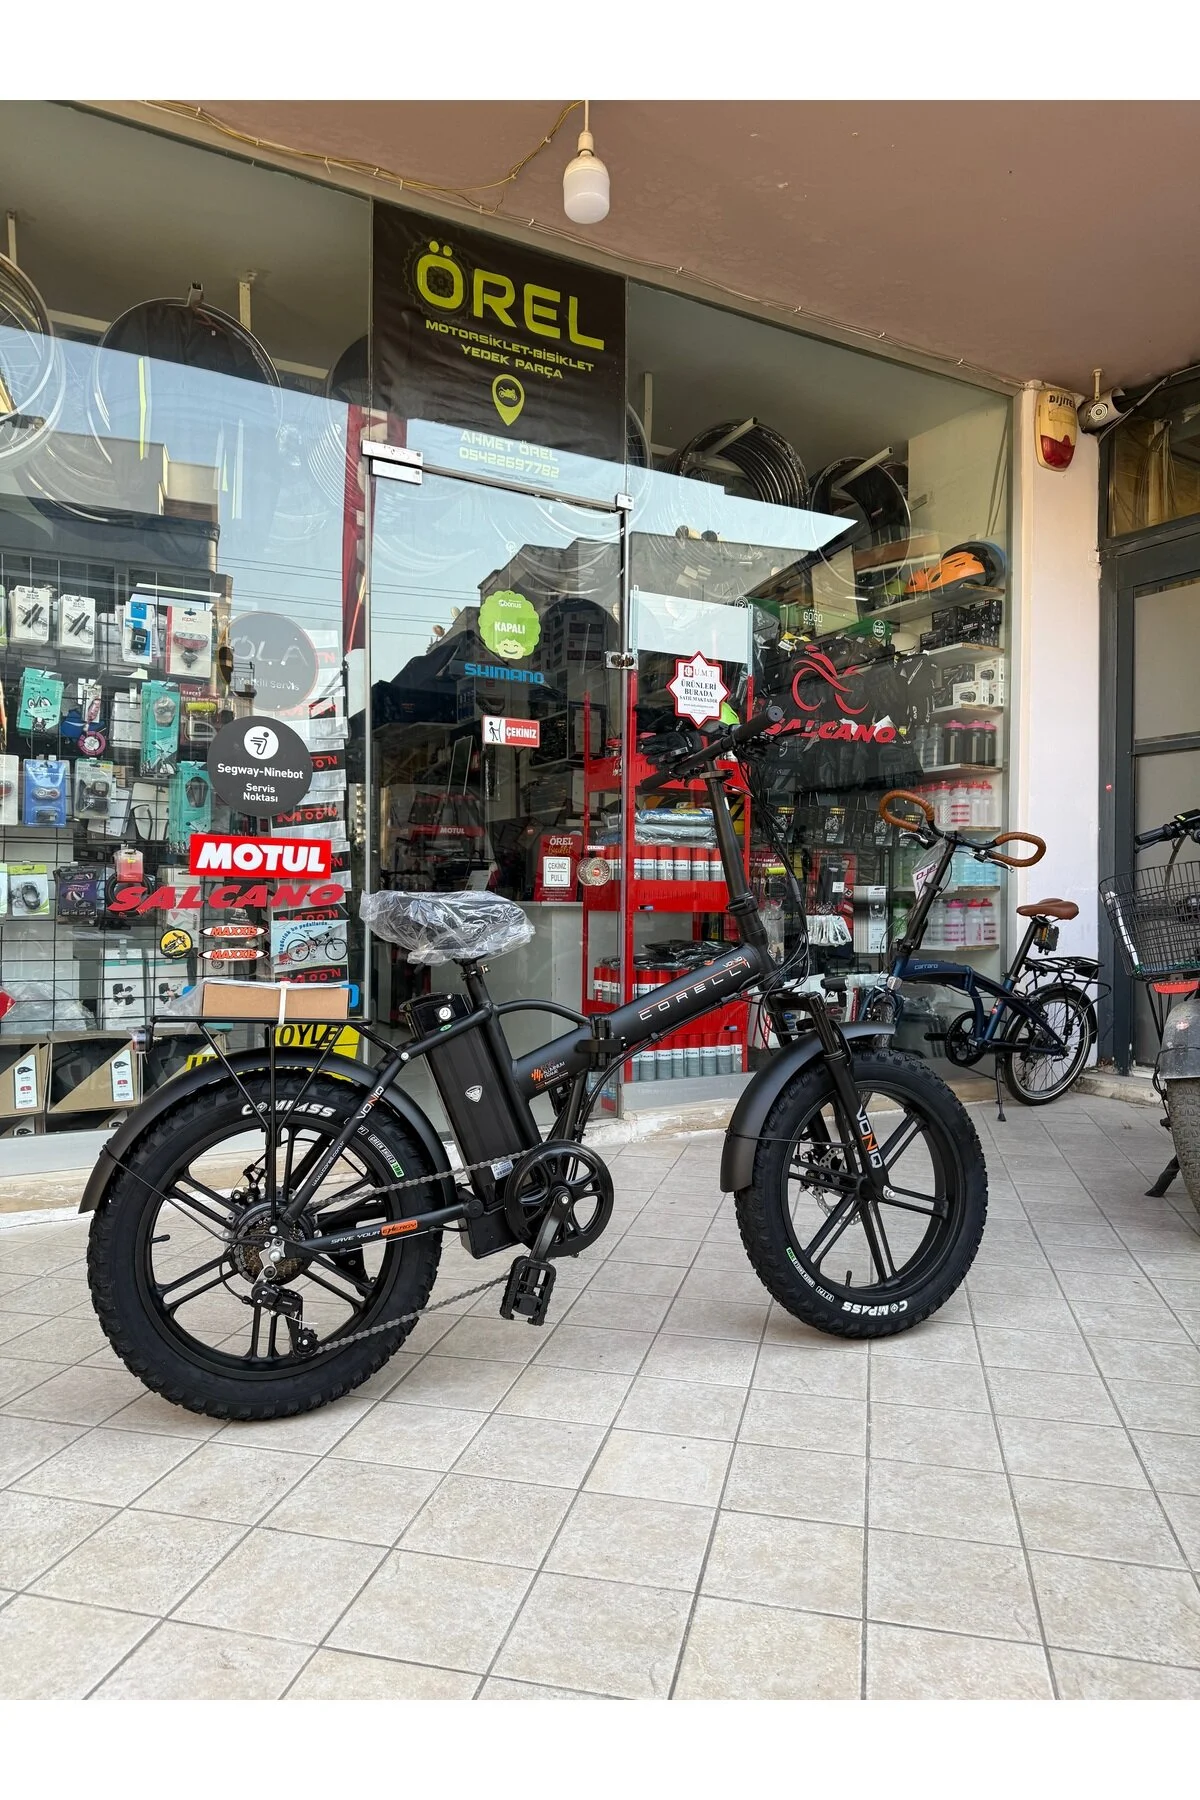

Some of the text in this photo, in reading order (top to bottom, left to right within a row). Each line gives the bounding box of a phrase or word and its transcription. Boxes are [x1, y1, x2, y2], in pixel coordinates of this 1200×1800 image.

[417, 241, 605, 351] ÖREL
[426, 319, 594, 372] MOTORSİKLET-BİSİKLET
[461, 344, 563, 379] YEDEK PARÇA
[460, 430, 559, 462] AHMET ÖREL
[459, 446, 560, 479] 05422697782
[494, 621, 525, 634] KAPALI
[464, 663, 545, 685] SHIMANO
[681, 679, 717, 690] ÜRÜNLERİ
[685, 688, 713, 697] BURADA
[505, 726, 537, 740] ÇEKİNİZ
[764, 718, 897, 743] SALCANO
[217, 763, 304, 779] Segway-Ninebot
[246, 783, 276, 793] Servis
[243, 792, 278, 802] Noktası
[549, 836, 573, 845] ÖREL
[196, 842, 326, 873] MOTUL
[550, 874, 564, 882] PULL
[107, 884, 346, 912] SALCANO
[210, 926, 258, 937] MAXXIS
[210, 949, 258, 960] MAXXIS
[356, 1085, 385, 1120] VONIQ
[856, 1104, 882, 1169] VONIQ
[331, 1236, 354, 1245] SAVE
[356, 1230, 381, 1239] YOUR
[841, 1300, 908, 1317] COMPASS
